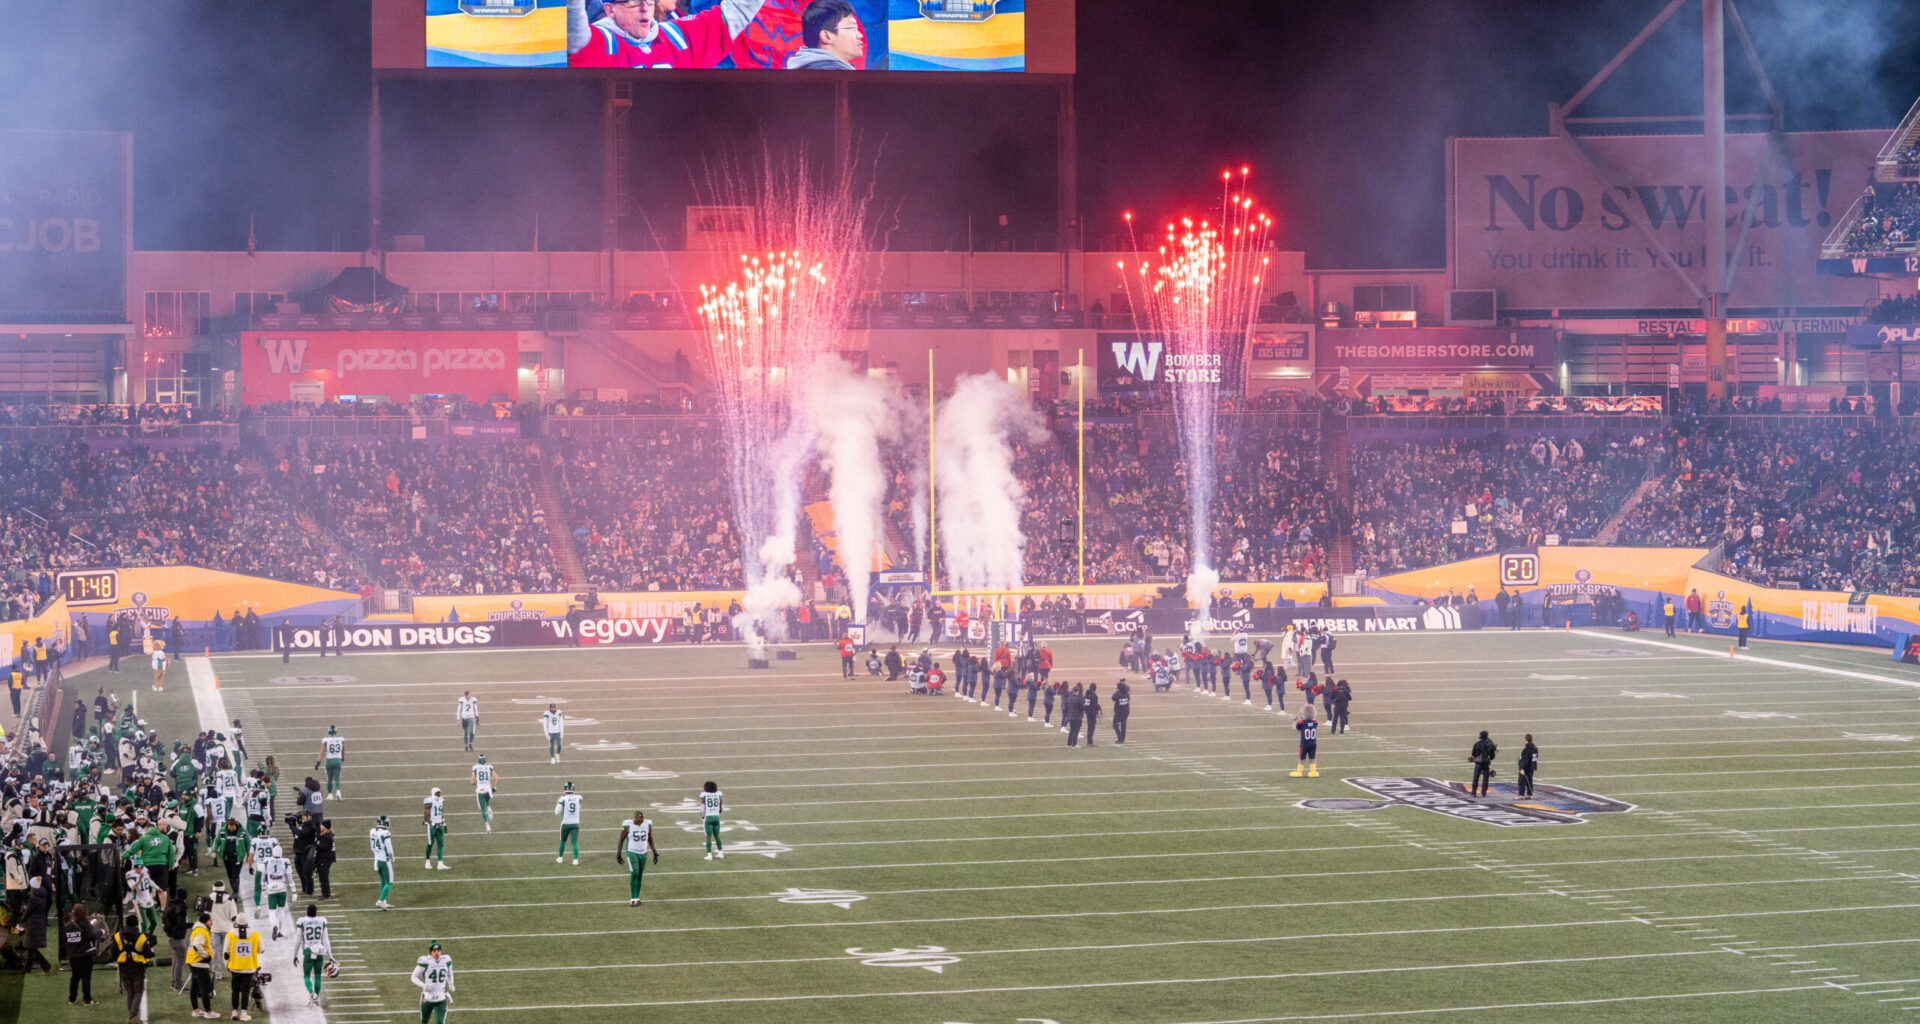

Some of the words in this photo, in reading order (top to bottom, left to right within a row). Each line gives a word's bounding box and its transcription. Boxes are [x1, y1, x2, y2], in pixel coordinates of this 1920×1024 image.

[1484, 174, 1584, 232] No
[1486, 248, 1533, 270] You
[1541, 249, 1608, 270] drink
[1615, 249, 1638, 269] it.
[1649, 248, 1693, 269] You
[1748, 248, 1772, 268] it.
[1851, 258, 1868, 274] W
[1637, 320, 1744, 334] RESTAURNT
[1747, 319, 1785, 333] ROW
[1335, 344, 1534, 358] THEBOMBERSTORE.COM
[337, 348, 418, 379] pizza
[423, 347, 506, 378] pizza
[1165, 354, 1222, 367] BOMBER
[1164, 369, 1221, 383] STORE
[1506, 559, 1533, 580] 20
[69, 575, 112, 599] 17:48
[144, 607, 169, 621] CUP
[551, 617, 670, 643] Wegovy
[1292, 618, 1360, 632] TIMBER
[1364, 617, 1417, 632] MART
[465, 704, 471, 713] 7
[1304, 728, 1317, 740] 00
[329, 743, 341, 754] 63
[224, 776, 235, 788] 21
[478, 770, 488, 781] 81
[215, 804, 223, 816] 2
[433, 805, 443, 816] 15
[569, 803, 577, 814] 9
[632, 829, 647, 842] 52
[371, 838, 382, 850] 74
[257, 846, 273, 859] 39
[273, 864, 279, 873] 1
[141, 877, 150, 890] 12
[305, 926, 322, 941] 26
[237, 945, 250, 954] CFL
[428, 968, 447, 983] 46
